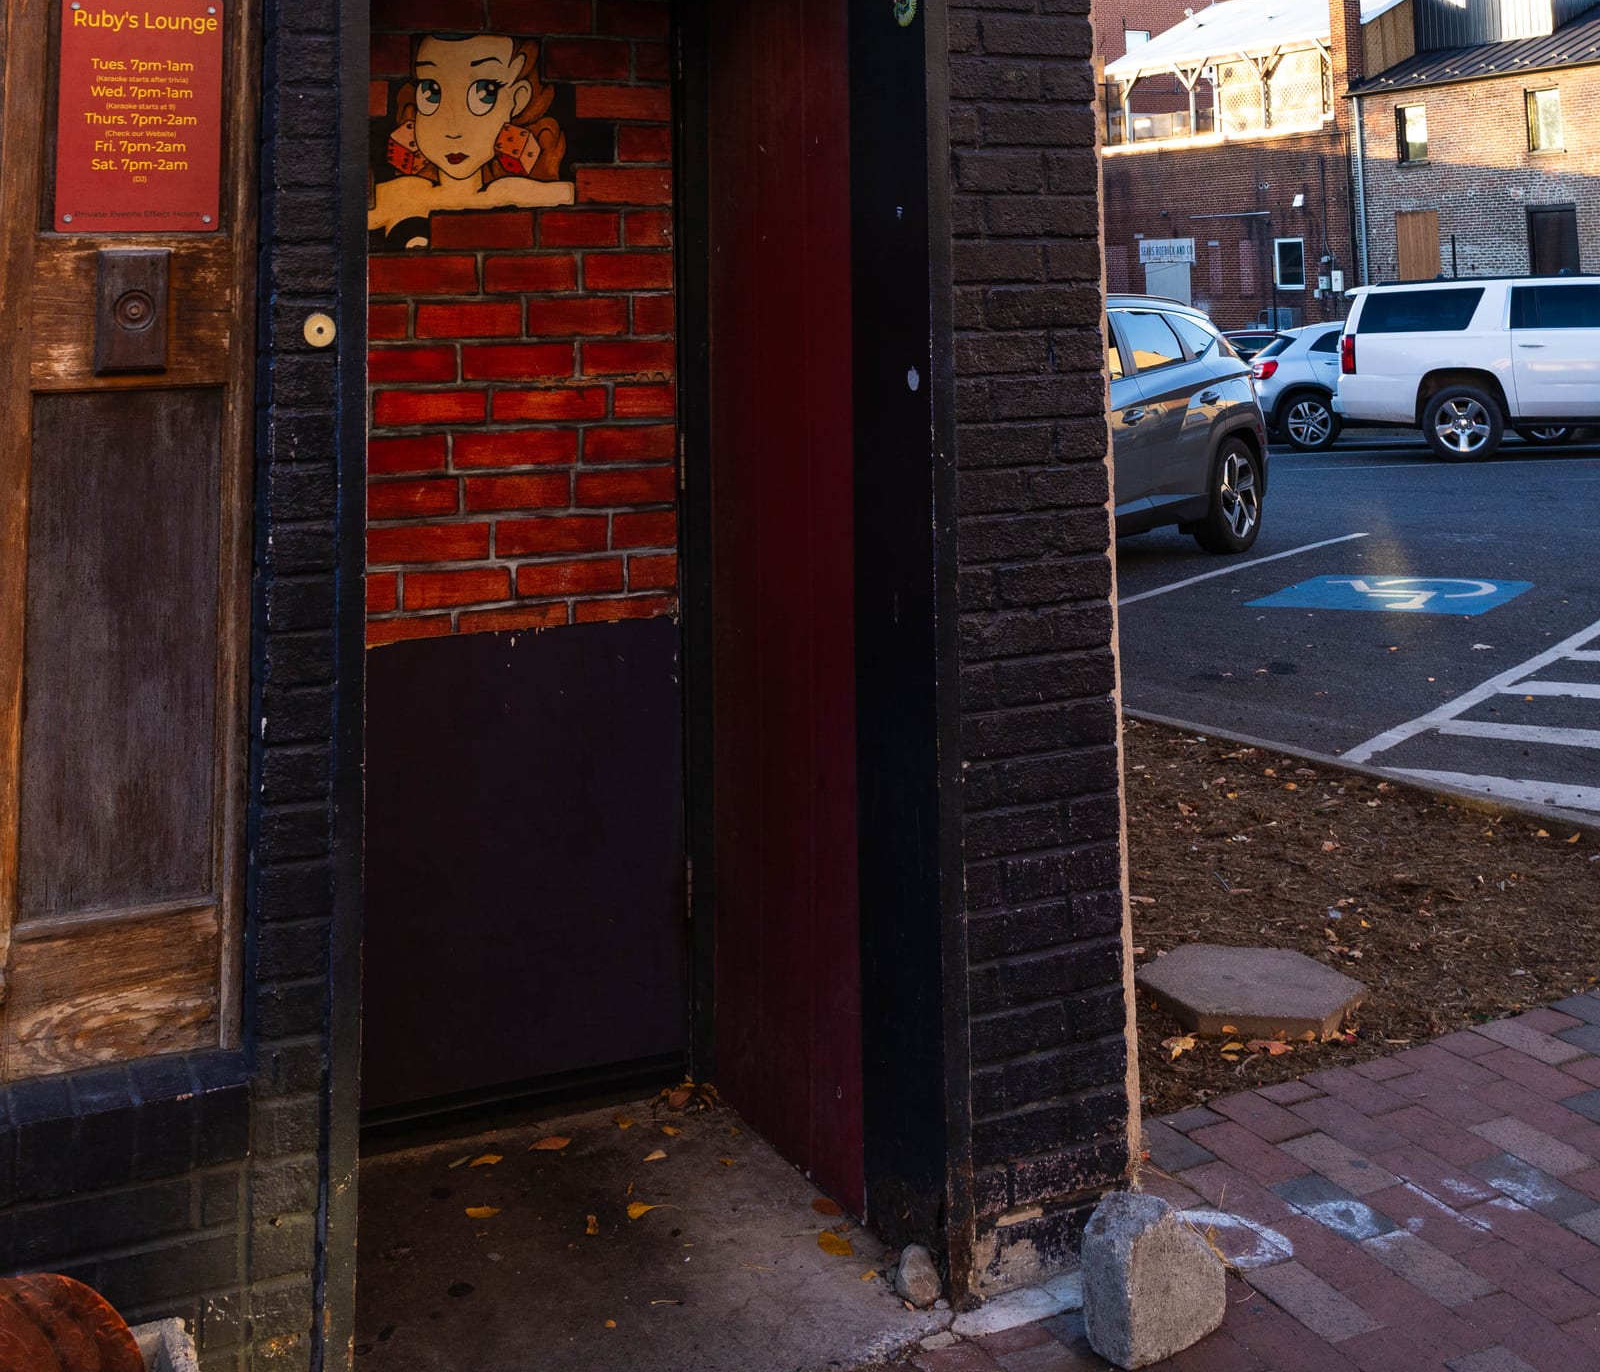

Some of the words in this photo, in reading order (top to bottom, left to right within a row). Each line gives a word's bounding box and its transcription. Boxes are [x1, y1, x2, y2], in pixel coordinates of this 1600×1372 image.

[73, 9, 139, 32] Ruby's
[144, 12, 218, 35] Lounge
[91, 58, 127, 70] Tues.
[130, 59, 194, 73] 7pm-1am
[96, 75, 127, 83] (Karaoke
[168, 76, 189, 84] trivia)
[91, 86, 127, 97] Wed.
[129, 86, 193, 100] 7pm-1am
[105, 102, 137, 110] (Karaoke
[84, 112, 128, 125] Thurs.
[130, 113, 197, 127] 7pm-2am
[105, 130, 130, 138] (Check
[145, 130, 176, 138] Website)
[95, 140, 116, 152] Fri.
[119, 140, 186, 154] 7pm-2am
[91, 158, 118, 170] Sat.
[121, 159, 188, 172] 7pm-2am
